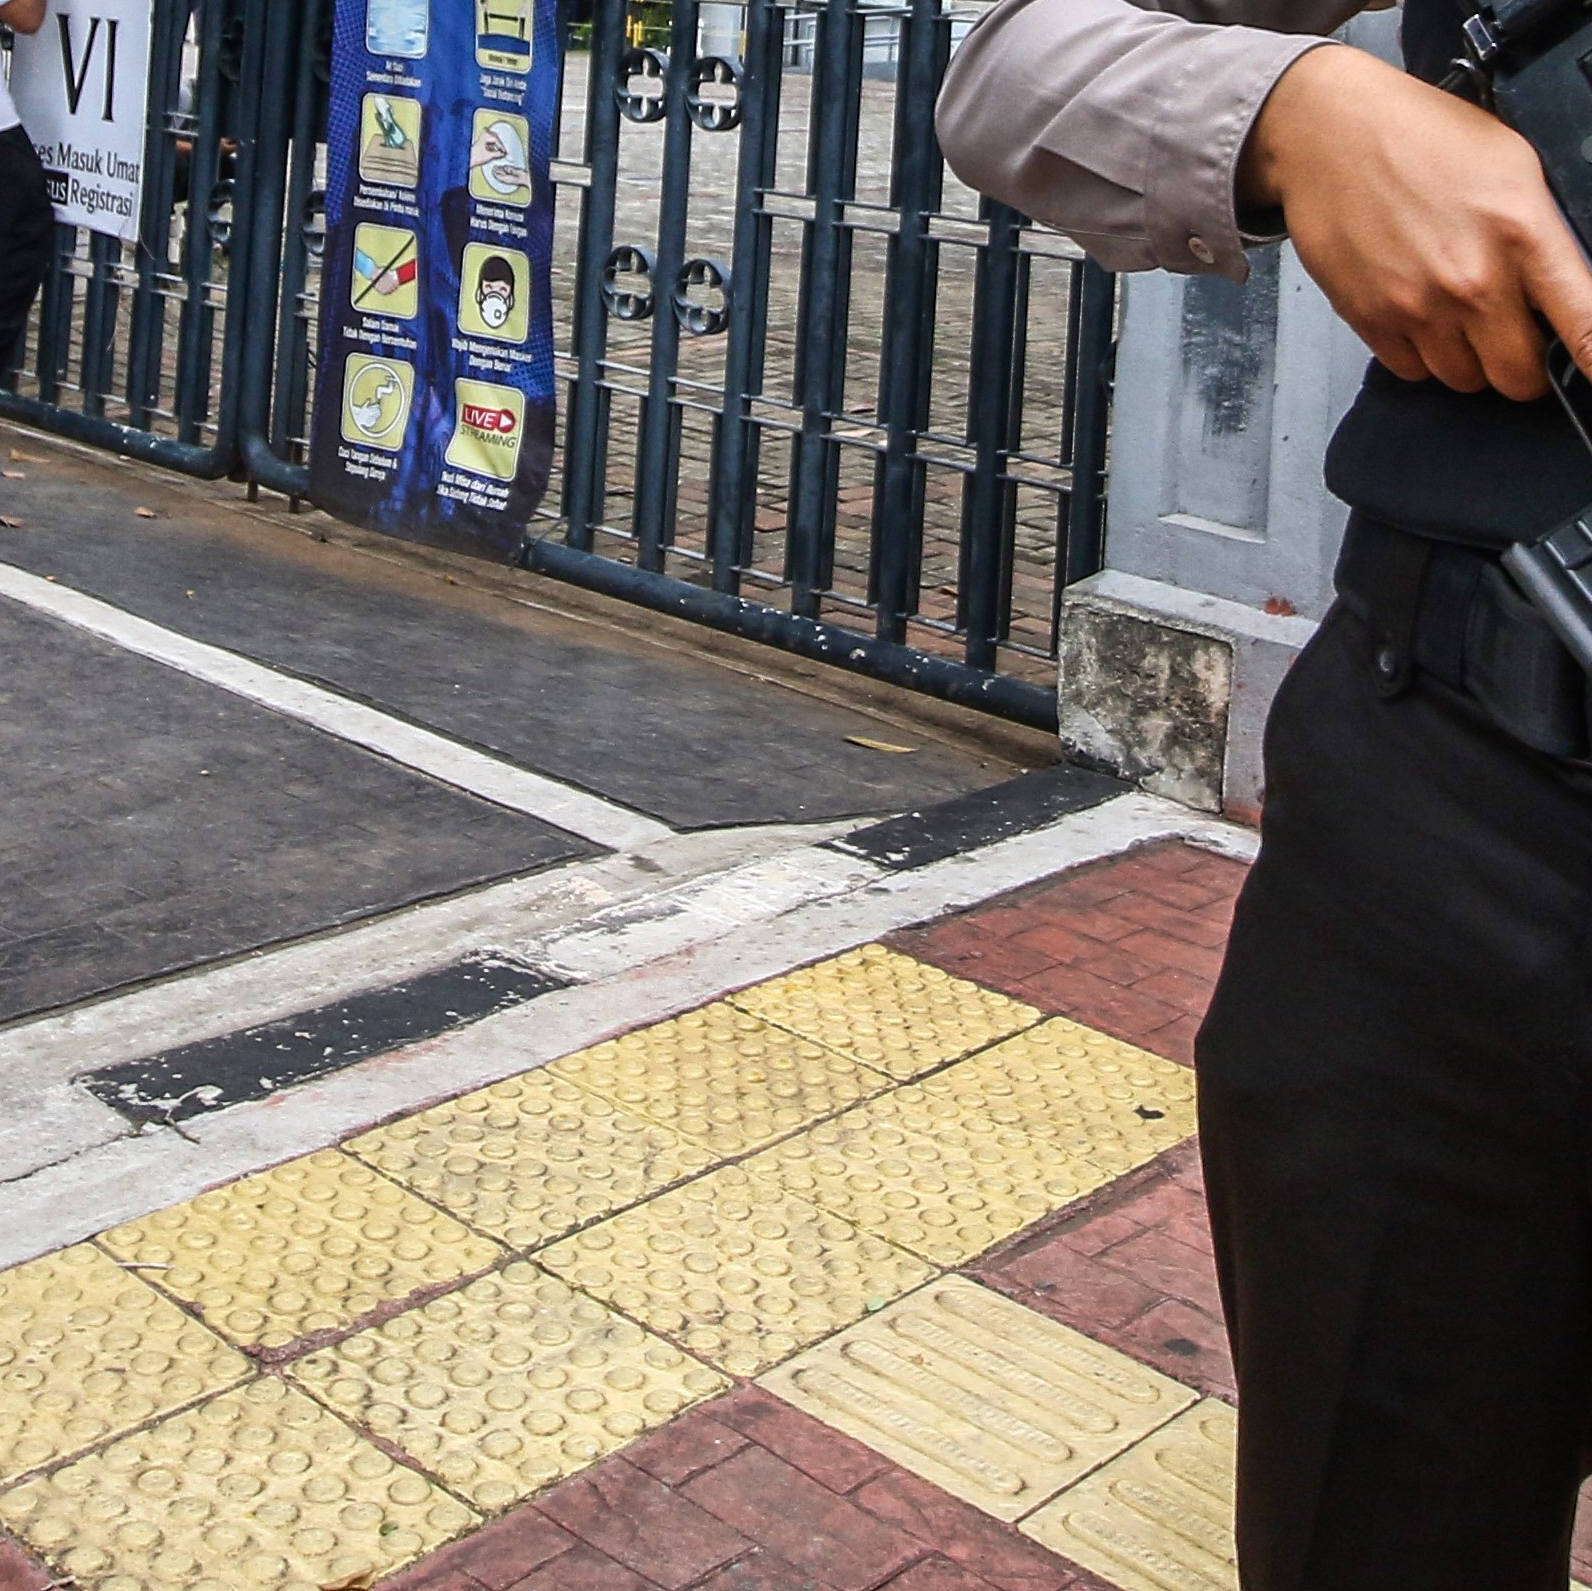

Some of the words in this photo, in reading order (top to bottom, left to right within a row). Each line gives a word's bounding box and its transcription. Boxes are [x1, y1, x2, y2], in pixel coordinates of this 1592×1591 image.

[56, 12, 120, 124] VI
[56, 142, 103, 175] Masuk
[106, 150, 141, 185] Umat
[70, 178, 133, 218] Registrasi
[460, 425, 517, 449] STREAMING
[464, 408, 496, 428] LIVE
